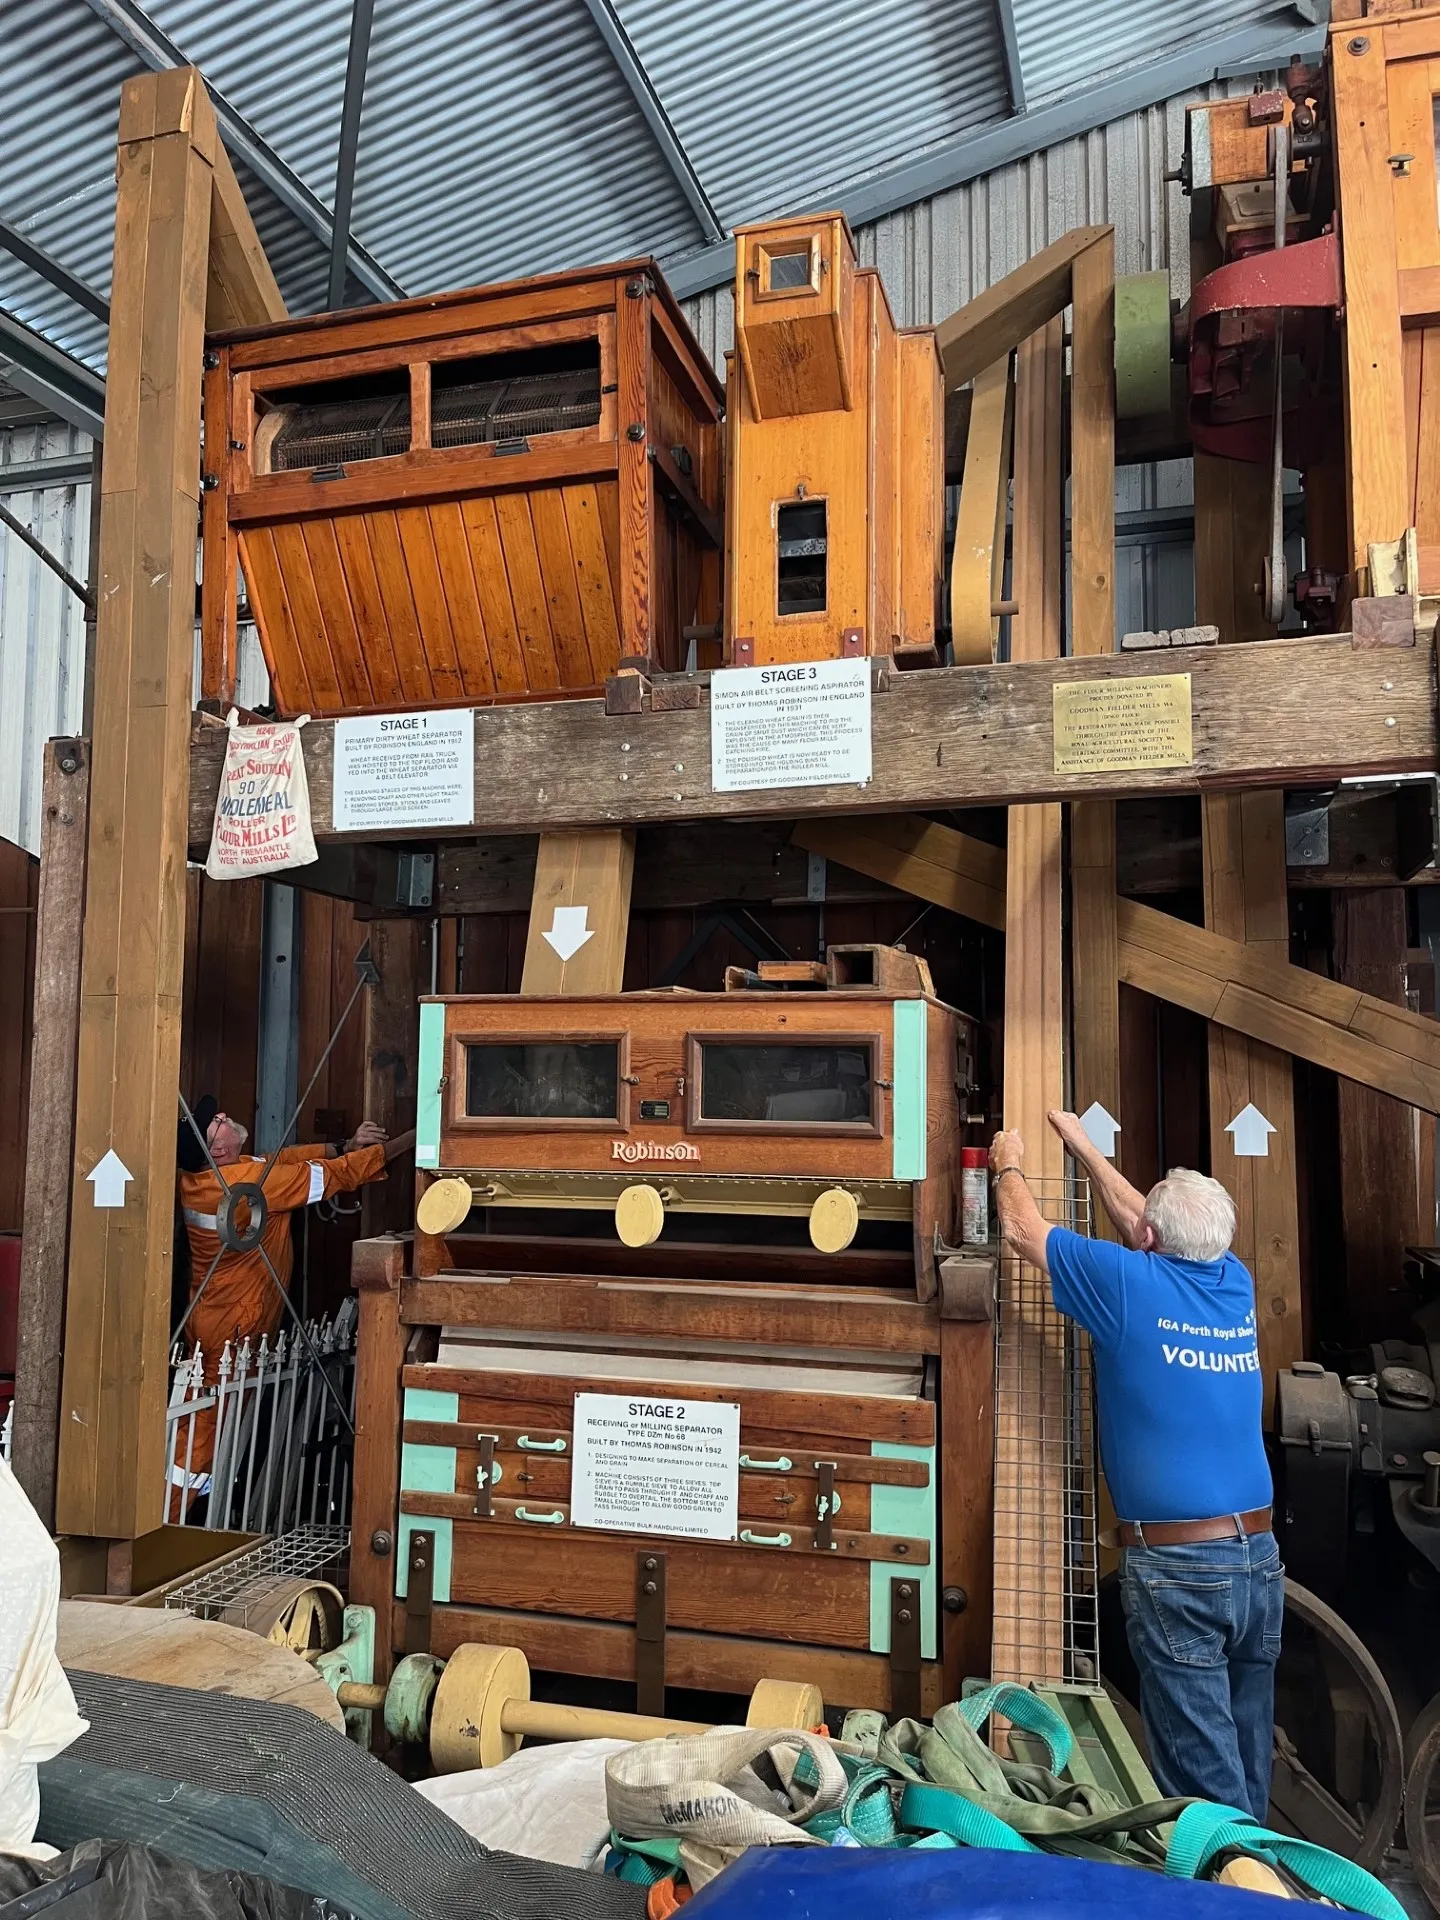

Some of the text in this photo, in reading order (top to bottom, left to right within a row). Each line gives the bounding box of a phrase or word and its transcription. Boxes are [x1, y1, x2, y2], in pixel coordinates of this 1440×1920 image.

[761, 668, 817, 683] STAGE 3
[776, 684, 819, 694] SCREENING
[821, 680, 864, 690] ASPIRATOR
[780, 697, 818, 705] ROBINSON
[830, 692, 864, 701] ENGLAND
[381, 718, 427, 731] STAGE 1
[422, 731, 462, 739] SEPARATOR
[227, 766, 245, 782] REAT
[239, 780, 255, 794] 90
[229, 816, 266, 828] ROLLER
[242, 824, 279, 847] MILLS
[241, 843, 291, 856] FREMANTLE
[242, 852, 290, 865] AUSTRALIA
[612, 1140, 700, 1163] Robinson
[1158, 1318, 1179, 1332] IGA
[1182, 1323, 1211, 1337] Perth
[1213, 1327, 1236, 1340] Royal
[1162, 1344, 1260, 1372] VOLUNTEE
[629, 1404, 685, 1419] STAGE 2
[588, 1419, 628, 1428] RECEIVING
[641, 1423, 672, 1432] MILLING
[674, 1425, 723, 1435] SEPARATOR
[621, 1440, 652, 1449] THOMAS
[654, 1443, 694, 1452] ROBINSON
[594, 1519, 635, 1527] CO-OPERATIVE
